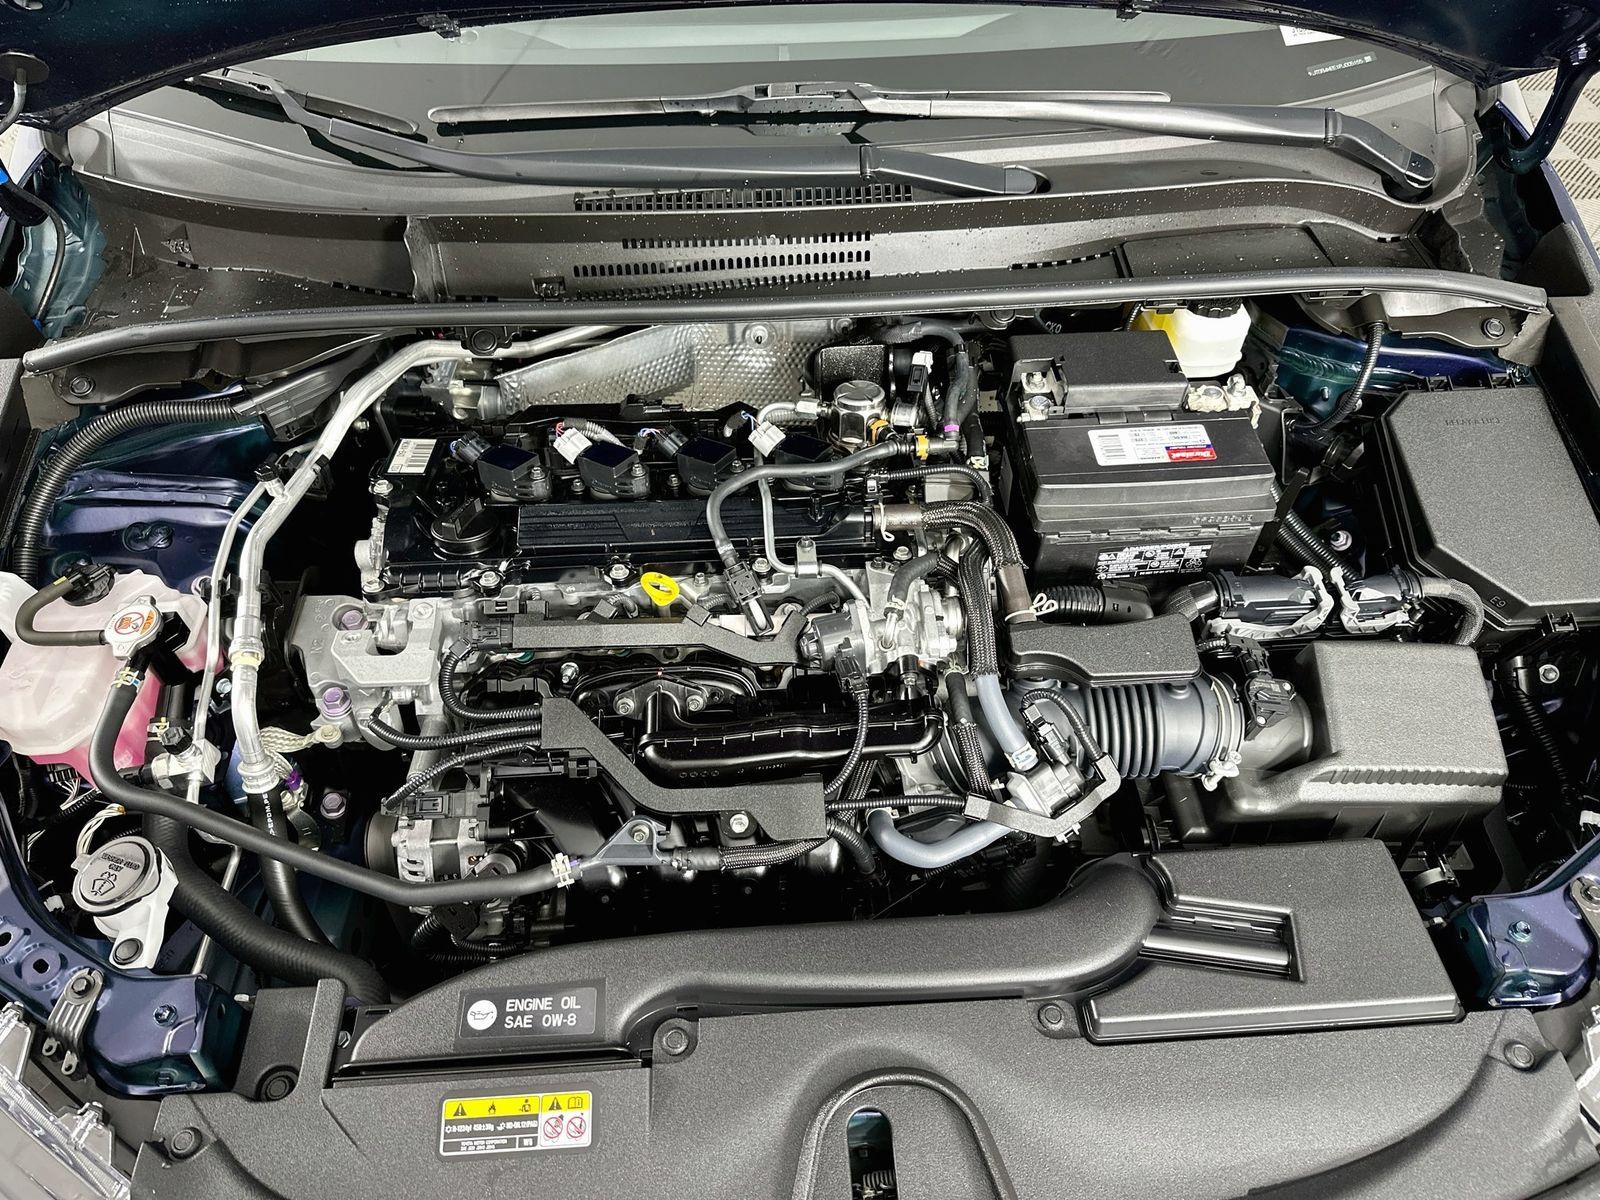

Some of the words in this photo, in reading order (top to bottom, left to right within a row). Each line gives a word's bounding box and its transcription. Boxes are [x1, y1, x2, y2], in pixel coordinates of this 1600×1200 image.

[506, 997, 553, 1012] ENGINE
[561, 996, 581, 1009] OIL
[504, 1015, 533, 1028] SAE
